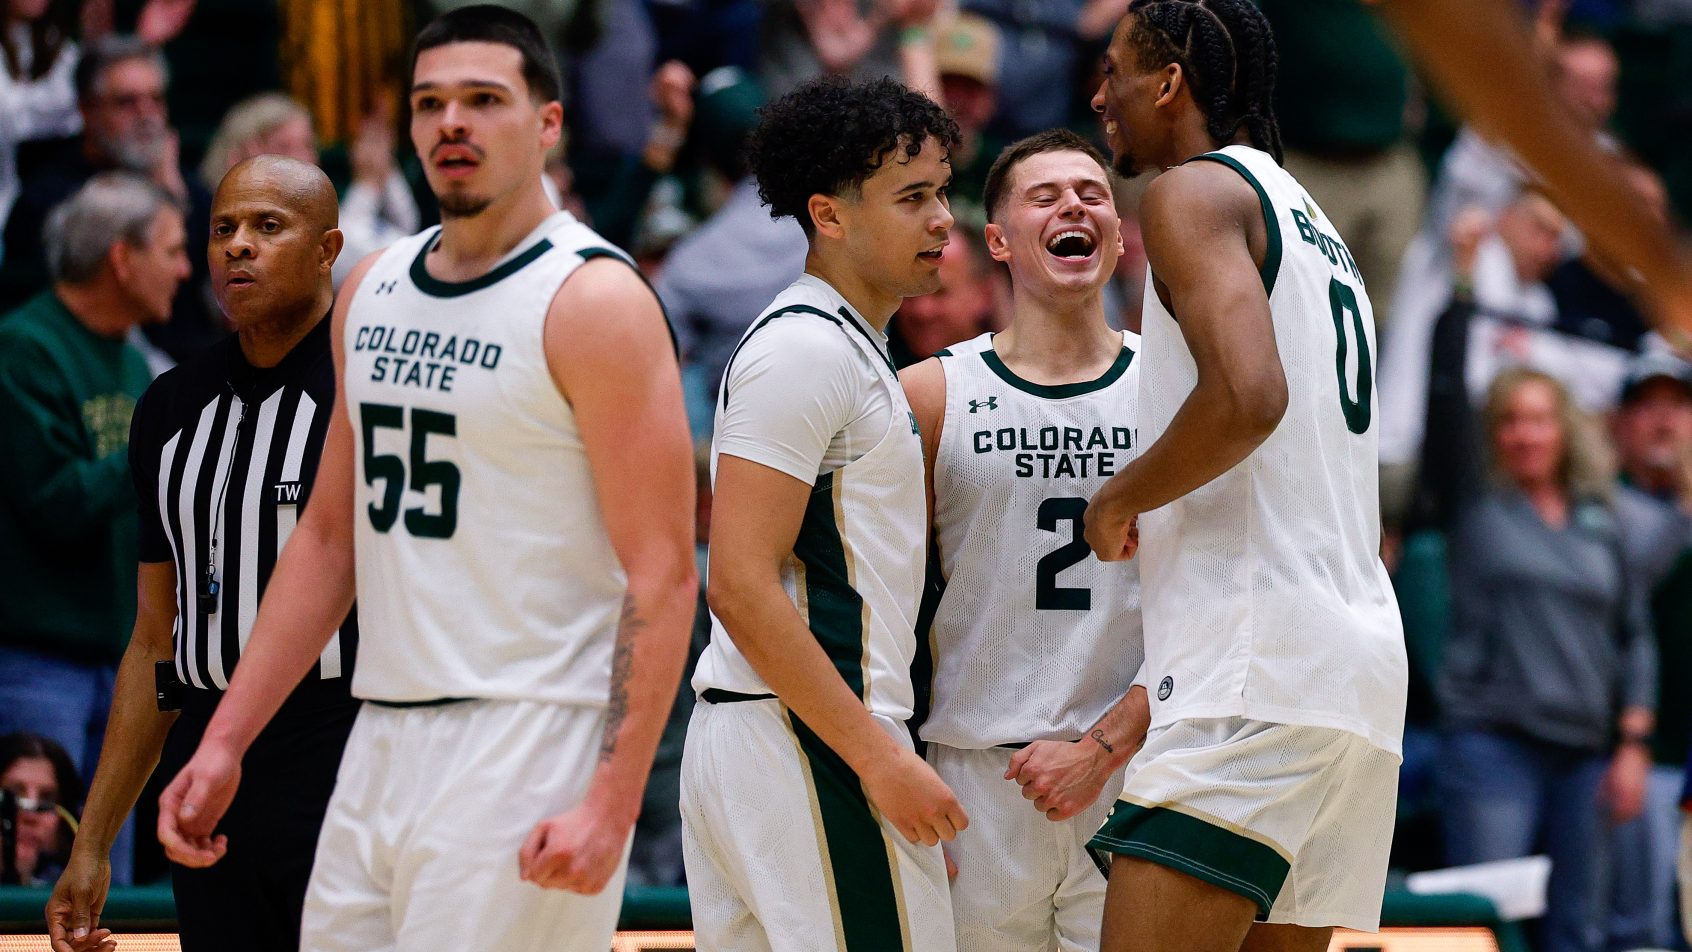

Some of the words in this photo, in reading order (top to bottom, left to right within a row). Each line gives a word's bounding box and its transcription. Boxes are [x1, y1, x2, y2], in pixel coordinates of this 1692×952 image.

[1290, 208, 1363, 286] BOOTH
[355, 326, 502, 370] COLORADO
[1329, 275, 1372, 434] 0
[371, 357, 457, 391] STATE
[973, 426, 1138, 454] COLORAD
[360, 402, 461, 539] 55
[1015, 453, 1115, 479] STATE
[274, 484, 301, 501] TW
[1036, 497, 1091, 611] 2
